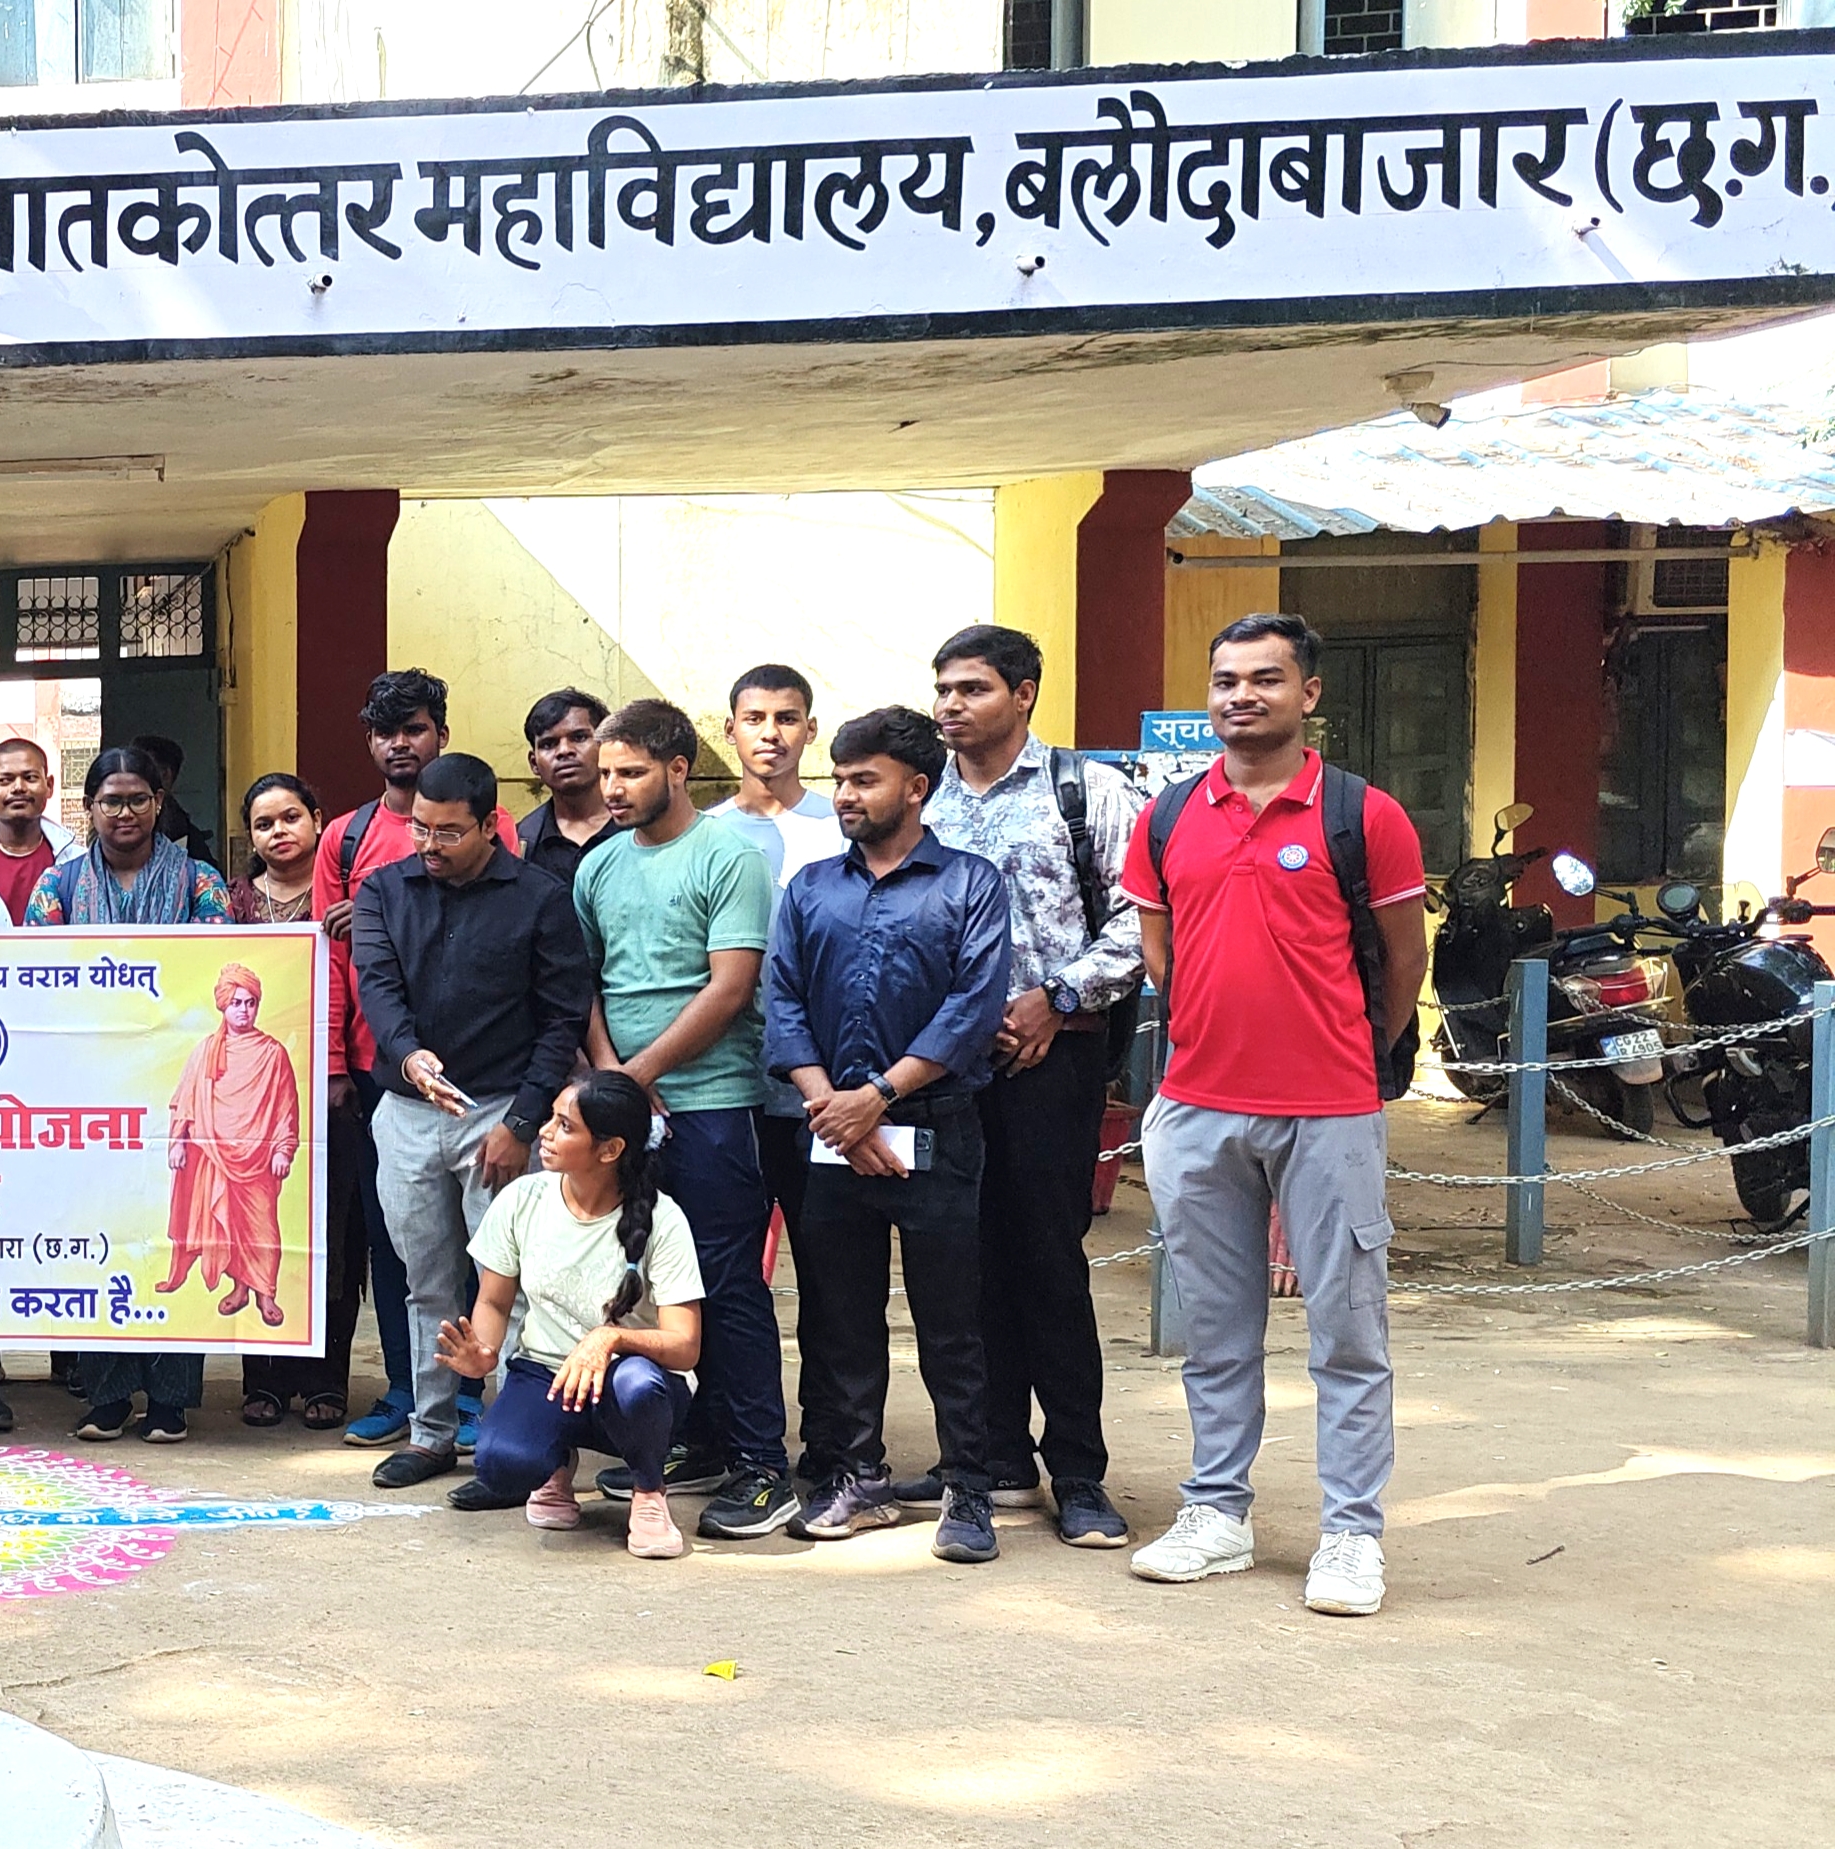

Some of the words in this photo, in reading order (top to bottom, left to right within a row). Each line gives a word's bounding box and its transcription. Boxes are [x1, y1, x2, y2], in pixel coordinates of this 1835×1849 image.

[1595, 99, 1835, 228] (छ.ग.
[89, 956, 159, 998] योधत्
[33, 1232, 110, 1265] (छ.ग.)
[9, 1287, 98, 1318] करता
